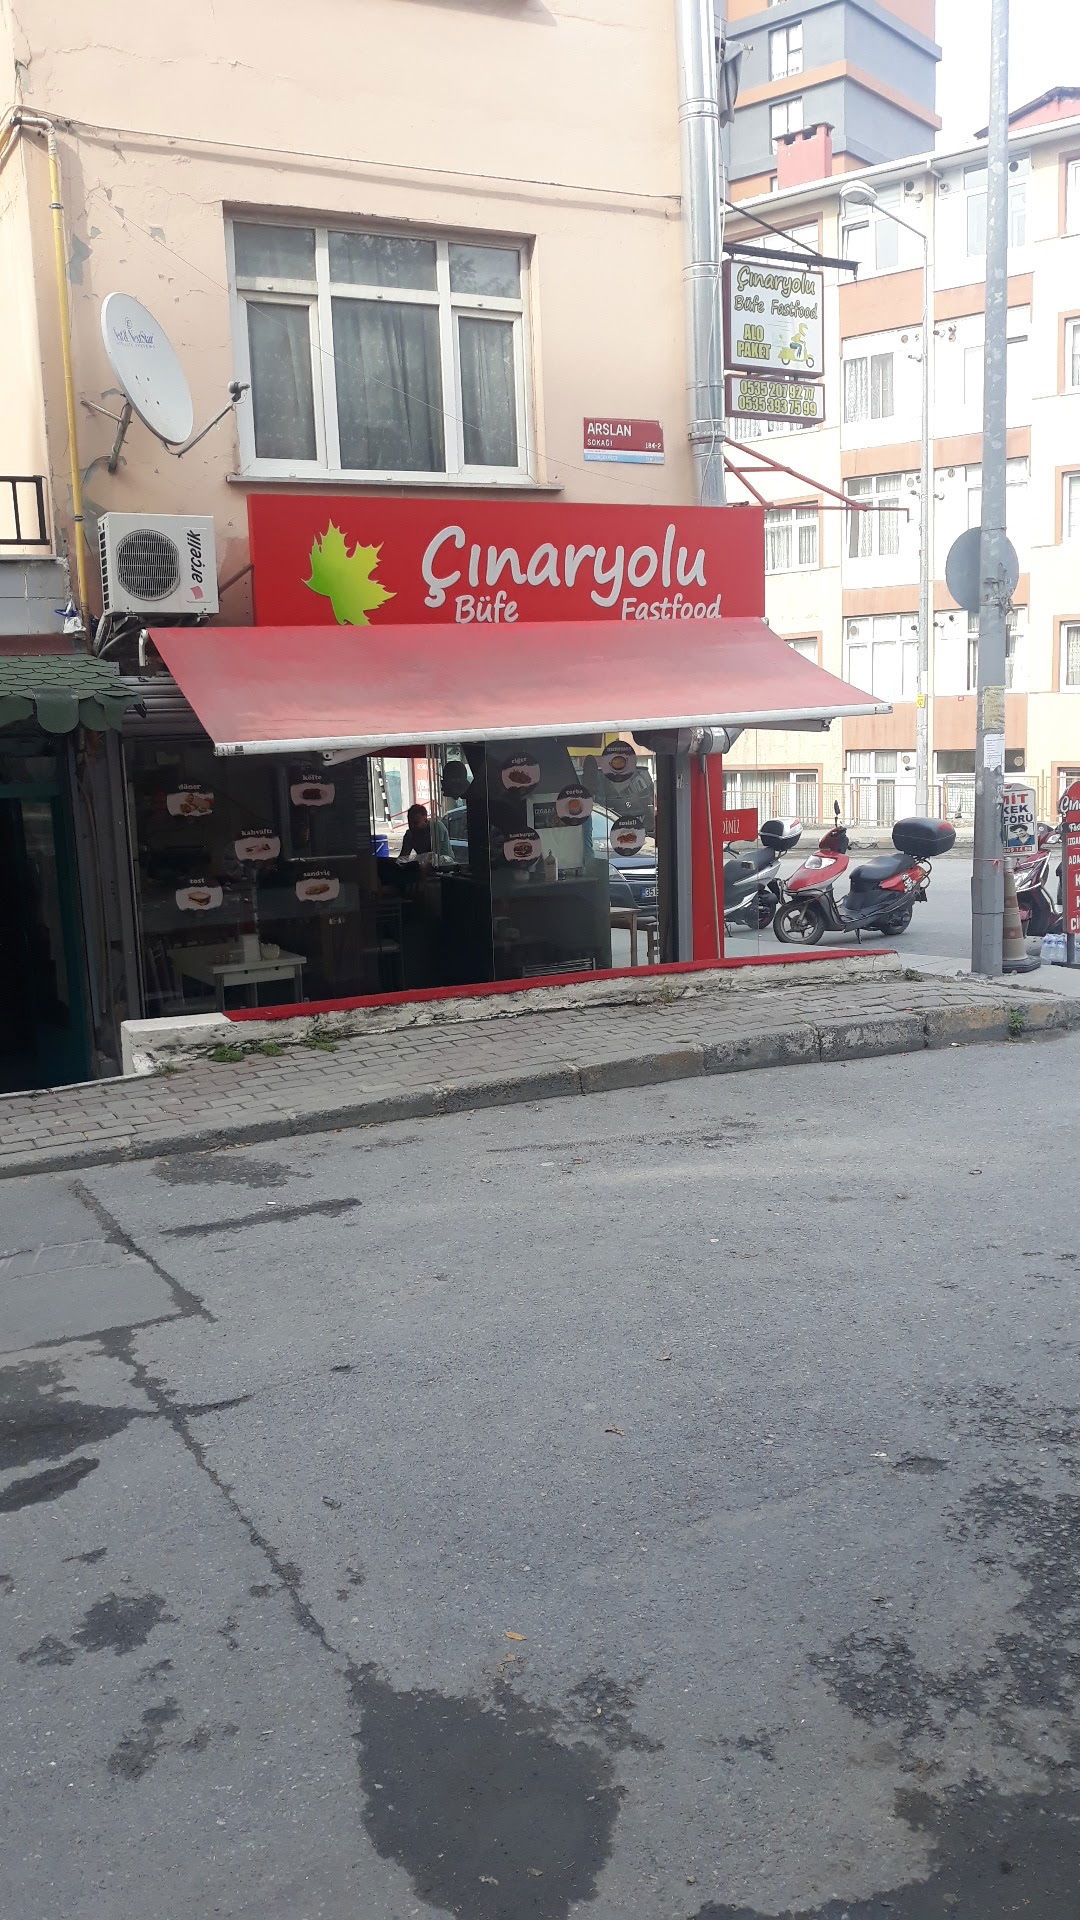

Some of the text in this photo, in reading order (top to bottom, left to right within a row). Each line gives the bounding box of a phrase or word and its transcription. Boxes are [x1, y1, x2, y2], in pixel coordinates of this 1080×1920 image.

[737, 266, 815, 298] Çınaryolu
[734, 295, 818, 319] Büfe Fastfood
[743, 324, 764, 342] ALO
[737, 340, 771, 360] PAKET
[740, 380, 768, 396] 0535
[769, 383, 788, 398] 207
[789, 384, 803, 399] 92
[738, 395, 817, 416] 0535 393 75 99
[587, 422, 632, 437] ARSLAN
[187, 530, 205, 583] arçelik
[421, 524, 707, 608] Çınaryolu
[455, 590, 722, 624] Büfe Fastfood
[1060, 796, 1080, 818] Çın
